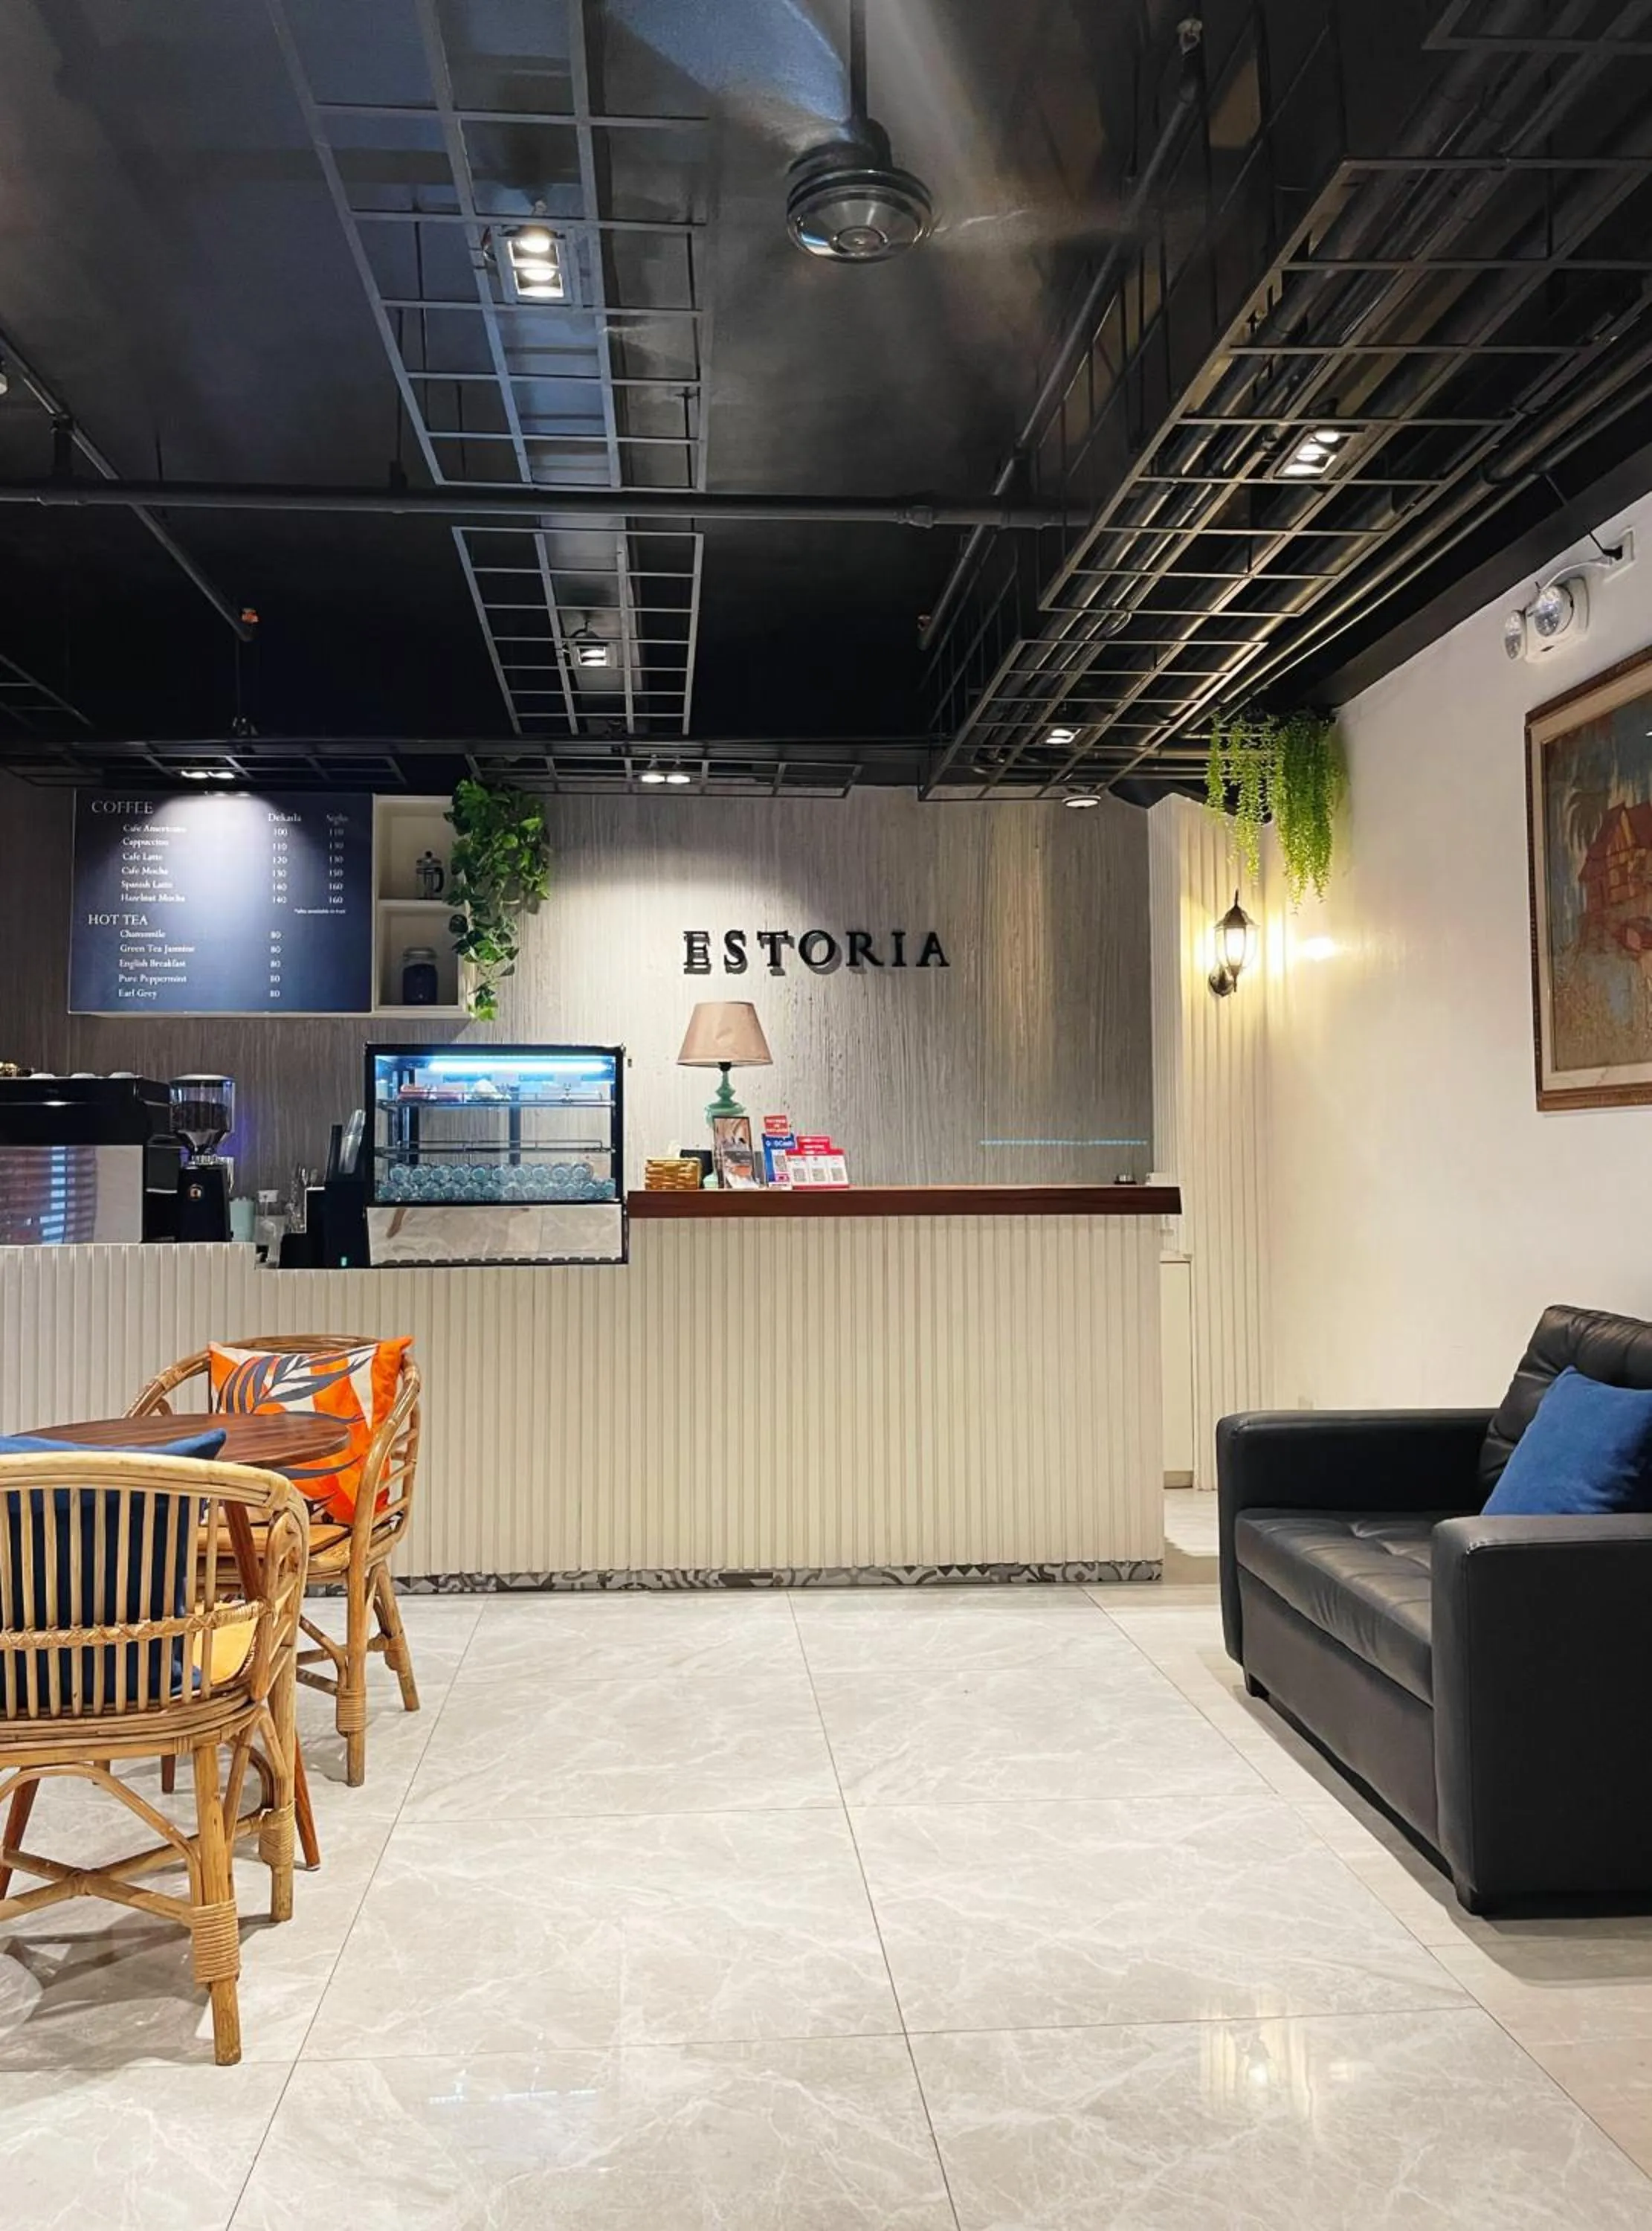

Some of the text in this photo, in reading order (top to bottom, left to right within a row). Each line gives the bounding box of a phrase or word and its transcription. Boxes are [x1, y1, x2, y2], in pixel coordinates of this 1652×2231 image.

[91, 800, 155, 814] COFFEE
[143, 825, 187, 833] Americano
[274, 828, 288, 836] 100
[123, 837, 170, 849] Cappuccino
[273, 843, 288, 851] 110
[123, 852, 141, 860] Cafe
[142, 852, 163, 861] Latte
[273, 856, 288, 865] 120
[121, 866, 139, 875] Cafe
[141, 866, 169, 875] Mocha
[273, 869, 287, 878] 130
[121, 880, 150, 891] Spanish
[152, 881, 173, 889] Latte
[120, 893, 156, 902] Hazelnut
[158, 893, 185, 902] Mocha
[329, 895, 343, 904] 160
[88, 913, 149, 926] HOT TEA
[120, 929, 167, 939] Chamomile
[120, 944, 146, 953] Green
[148, 944, 163, 953] Tea
[164, 944, 195, 955] Jasmine
[683, 929, 951, 970] ESTORIA
[118, 959, 282, 970] English Breakfast 80
[118, 973, 281, 985] Pure Peppermint 80
[118, 988, 135, 997] Earl
[136, 988, 158, 999] Grey
